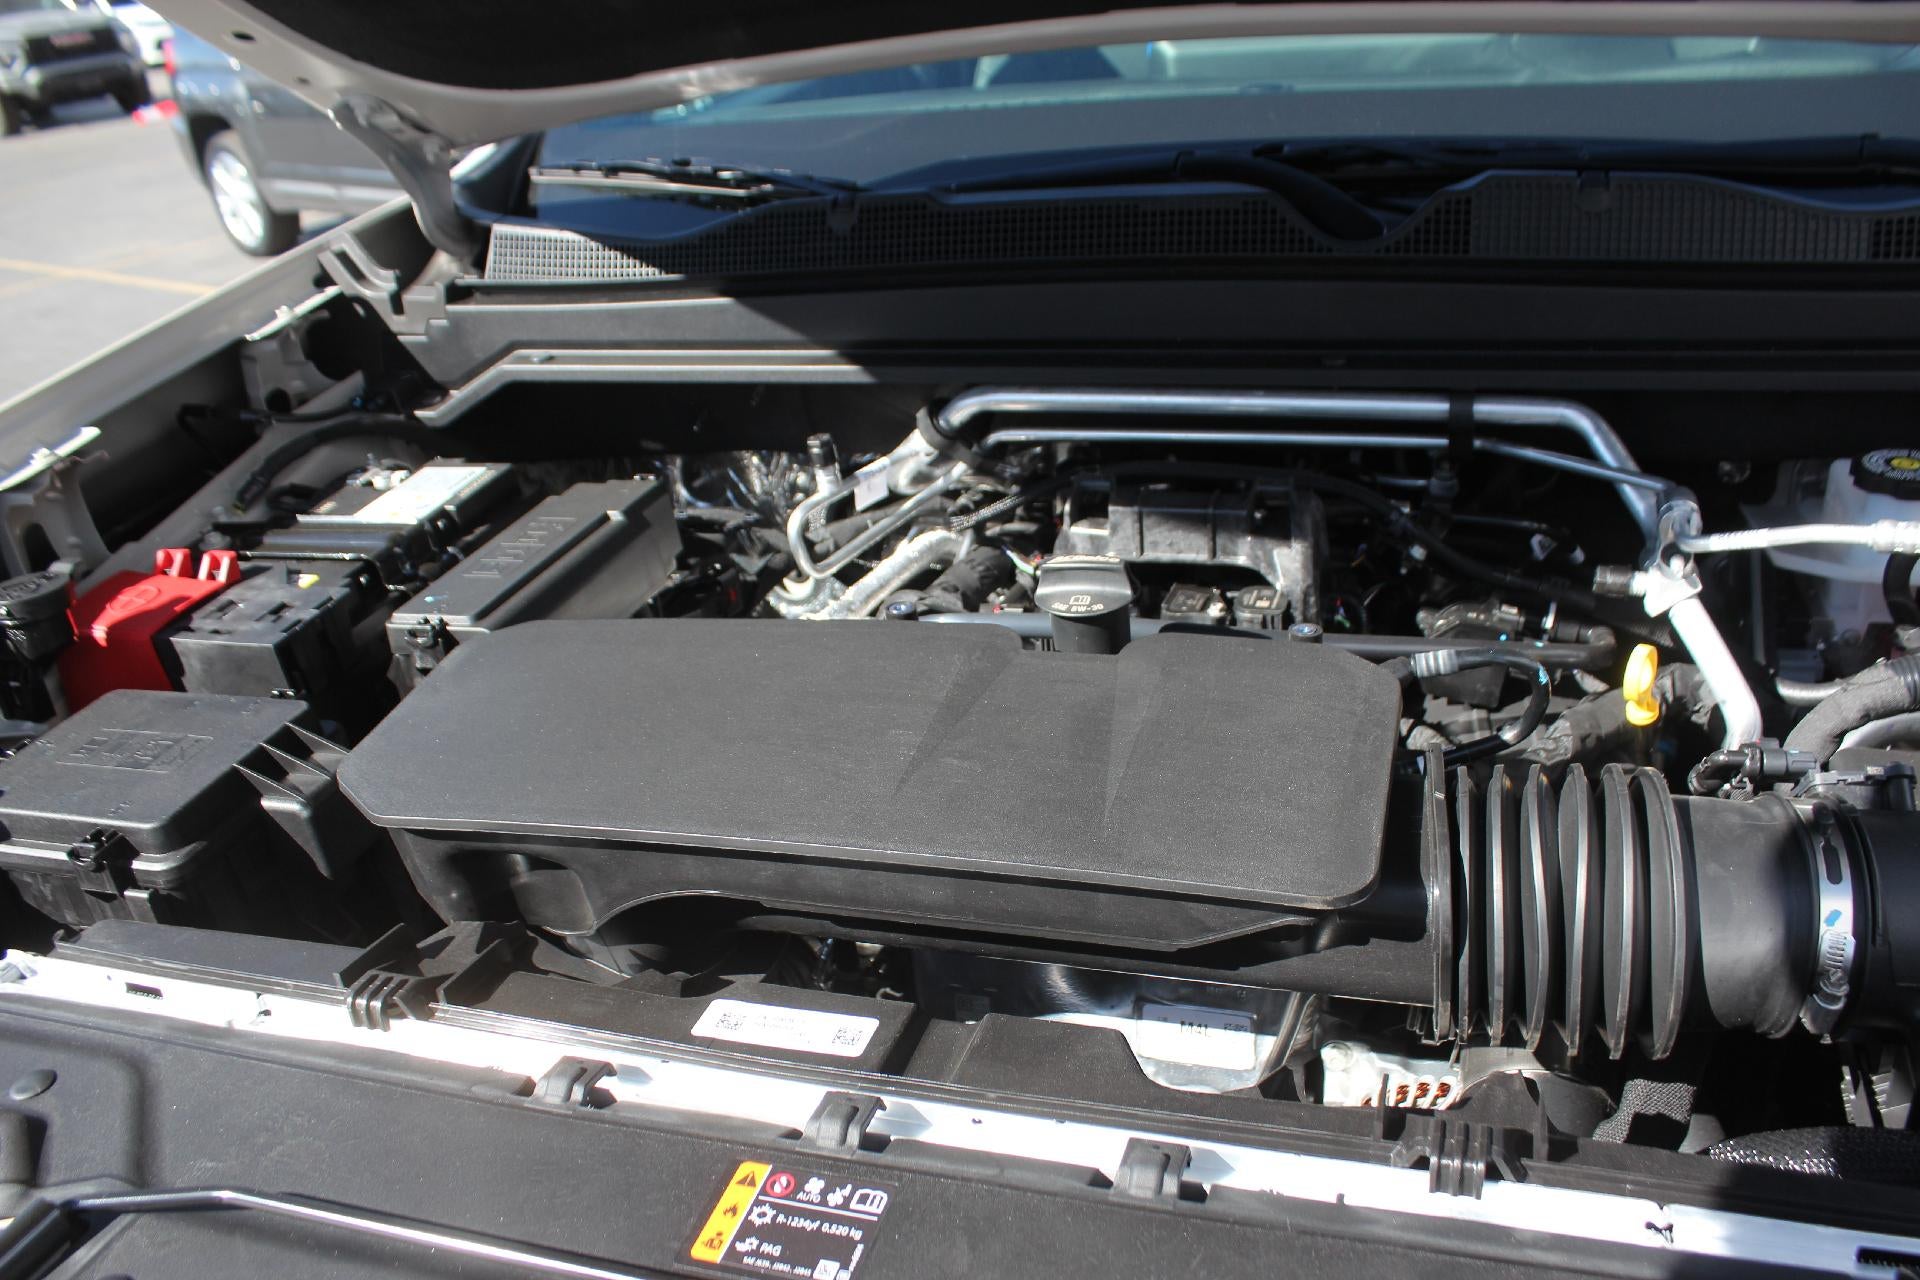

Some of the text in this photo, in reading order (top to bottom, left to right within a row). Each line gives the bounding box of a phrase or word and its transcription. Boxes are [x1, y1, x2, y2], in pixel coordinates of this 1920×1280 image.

[796, 1191, 821, 1203] AUTO
[776, 1213, 820, 1231] R-1234yf
[849, 1227, 863, 1241] kg
[759, 1242, 782, 1256] PAG
